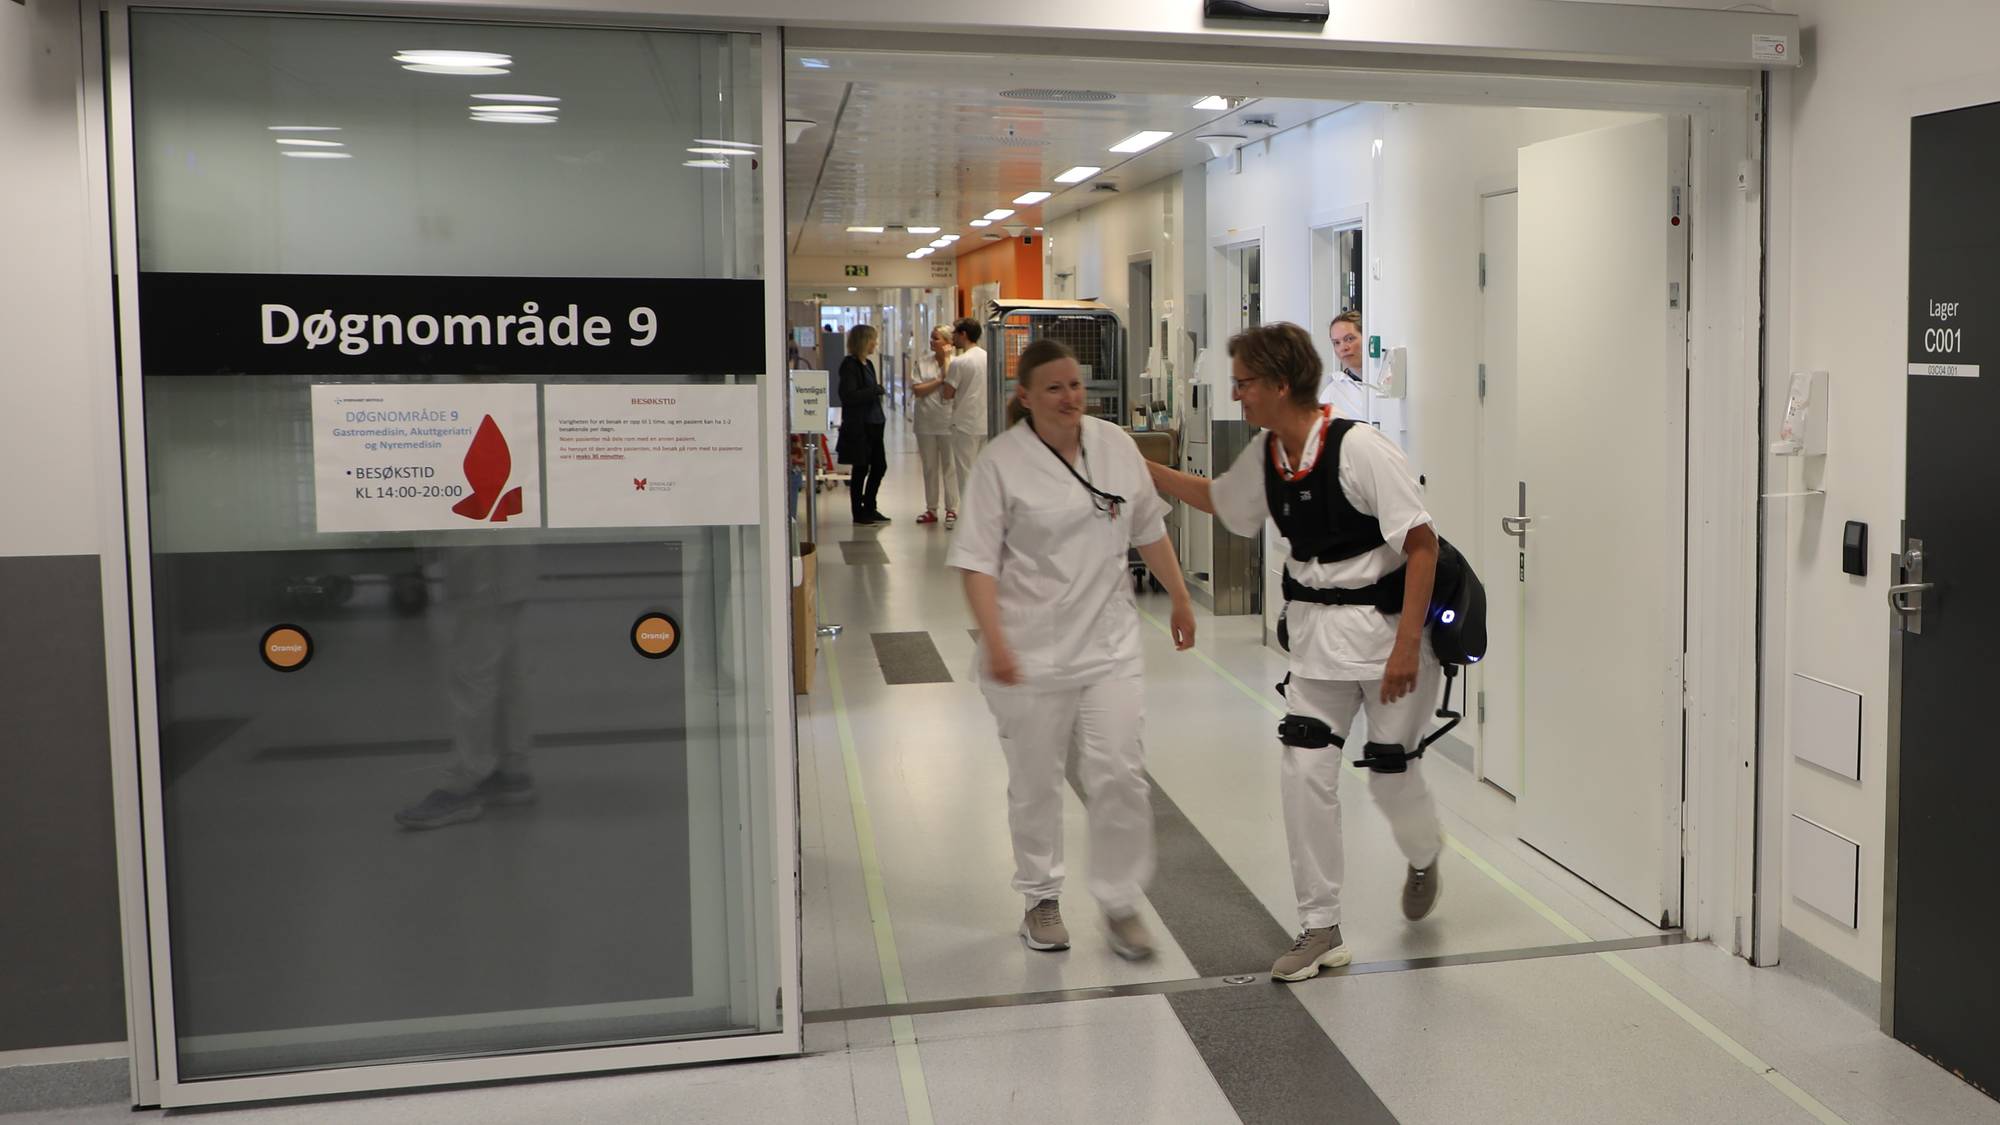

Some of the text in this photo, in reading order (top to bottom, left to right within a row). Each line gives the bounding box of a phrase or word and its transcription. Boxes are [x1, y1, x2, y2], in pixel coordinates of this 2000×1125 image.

[1929, 298, 1959, 321] Lager
[260, 301, 658, 355] Døgnområde 9
[1924, 327, 1961, 353] C001
[795, 385, 826, 395] Vennligst
[345, 408, 459, 423] DØGNOMRÅDE 9
[332, 426, 472, 437] Gastromedisin, Akuttgeriatri
[364, 441, 442, 451] og Nyremedisin
[356, 466, 435, 480] BESØKSTID
[355, 485, 463, 499] KL 14:00-20:00
[641, 632, 669, 640] Oransje
[271, 644, 302, 652] Oransje
